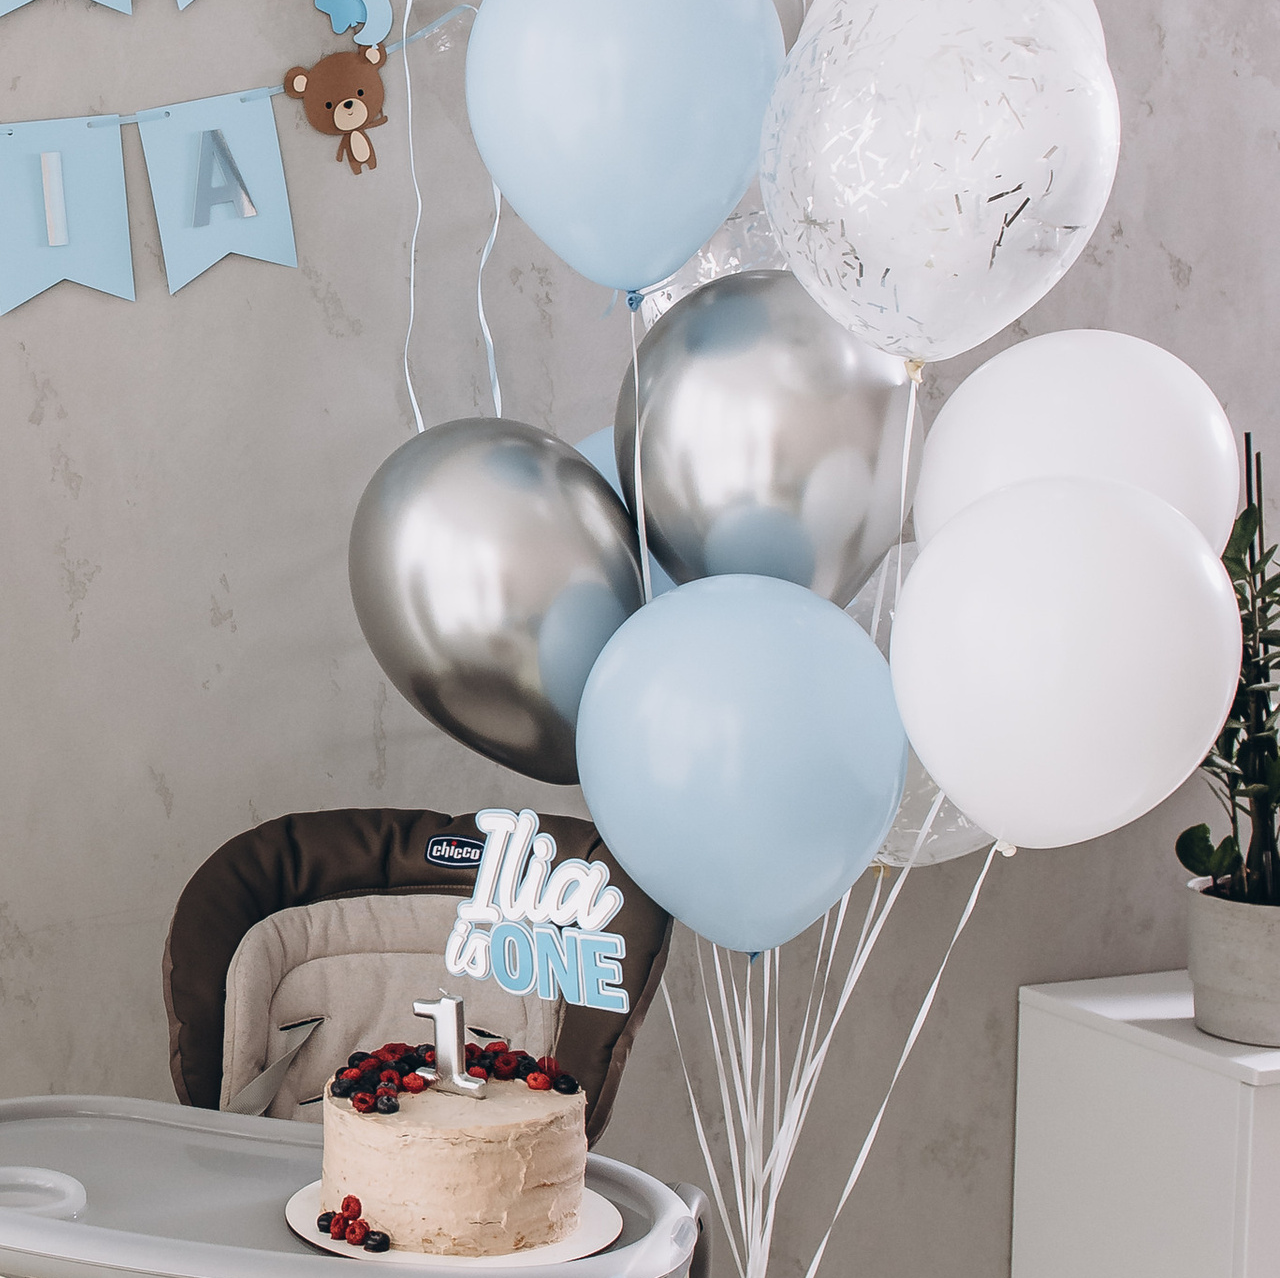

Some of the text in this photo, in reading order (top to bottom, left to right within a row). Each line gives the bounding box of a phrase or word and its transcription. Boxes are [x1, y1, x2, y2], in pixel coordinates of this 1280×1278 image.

[431, 840, 481, 860] chicco
[457, 809, 624, 932] Ilia
[447, 921, 629, 1014] is ONE
[411, 994, 487, 1100] 1
